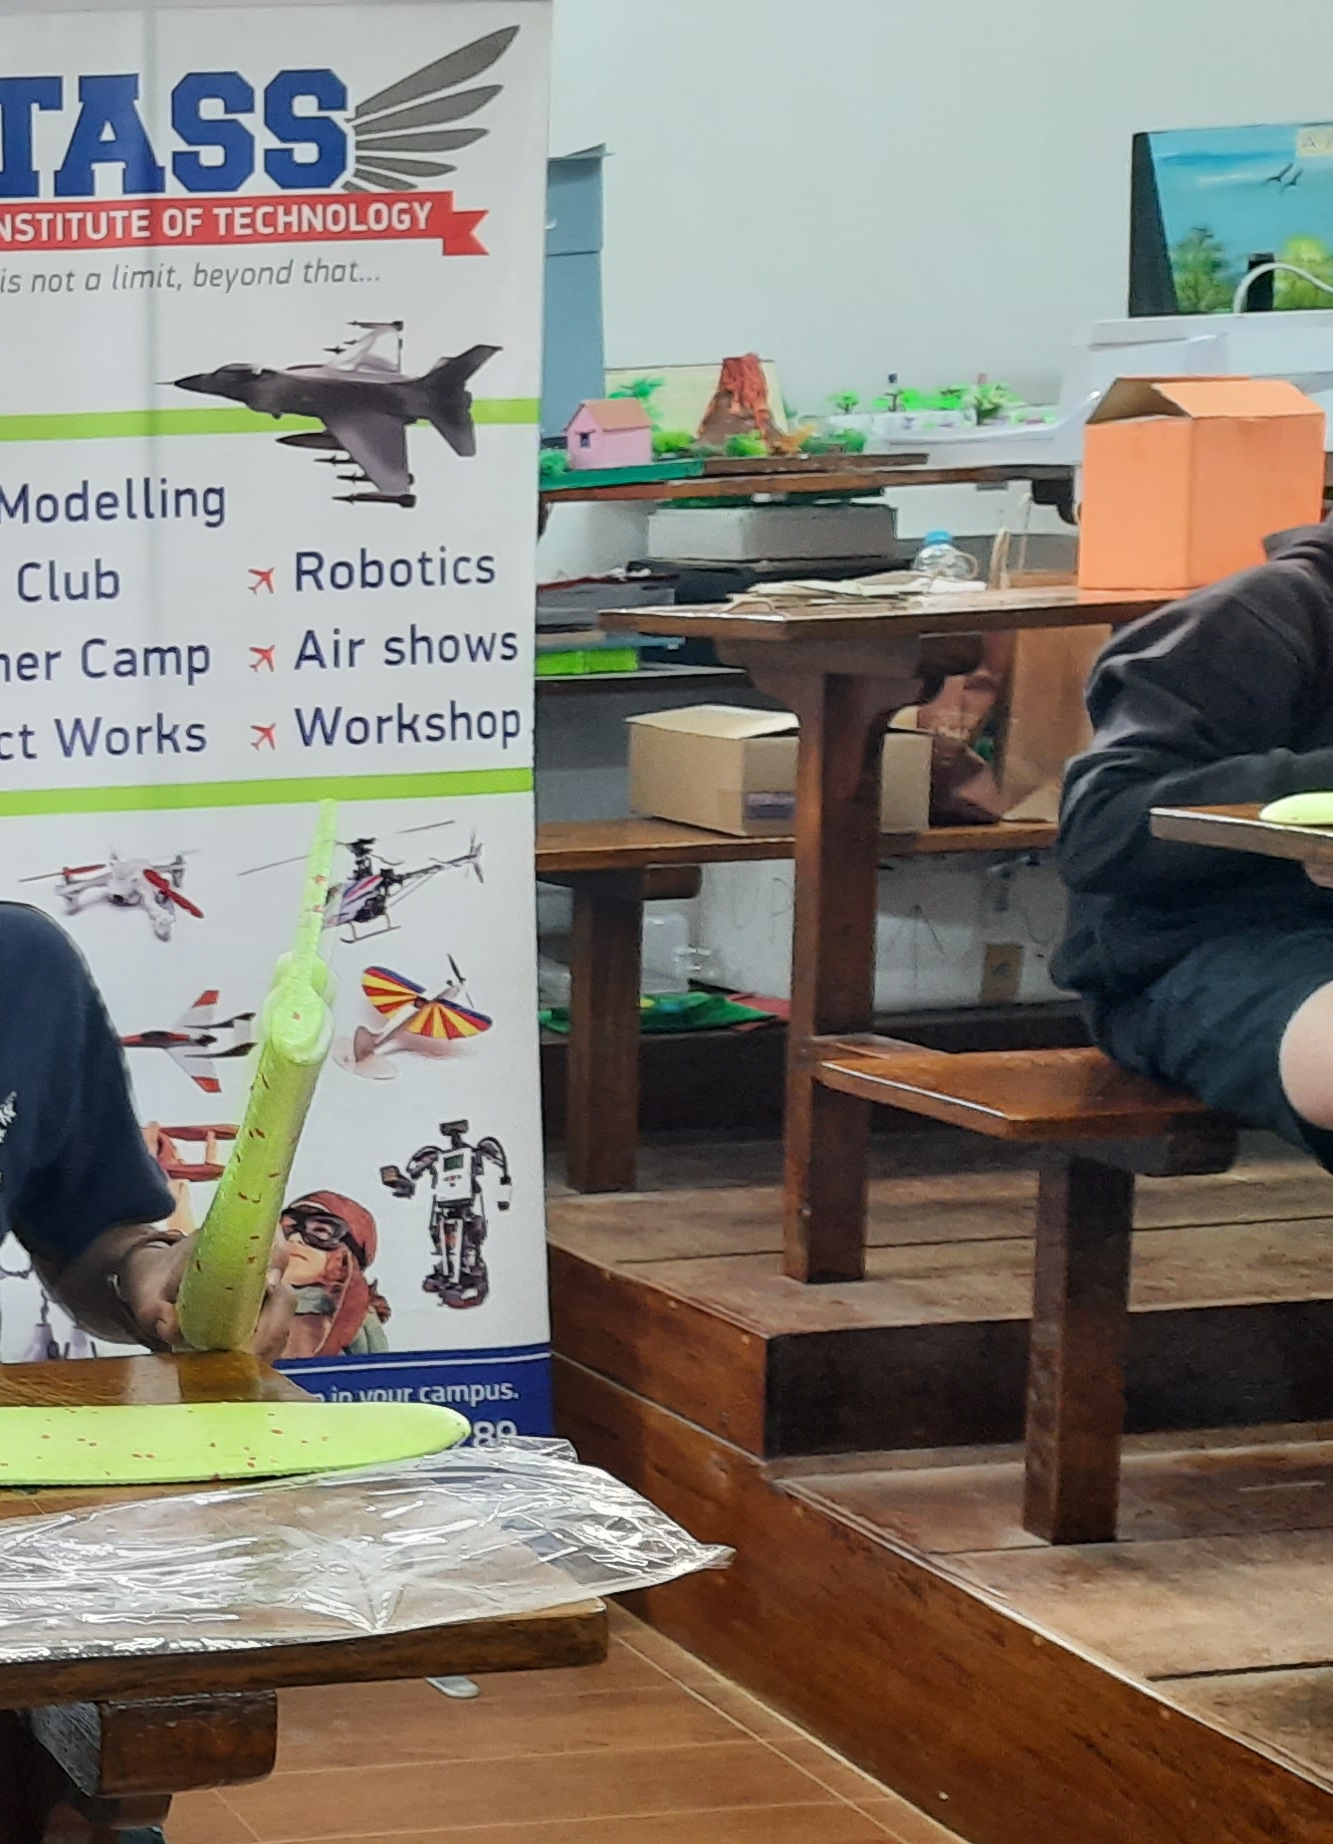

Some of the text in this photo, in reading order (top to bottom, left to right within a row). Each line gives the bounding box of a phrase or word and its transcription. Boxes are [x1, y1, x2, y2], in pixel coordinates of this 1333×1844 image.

[162, 207, 204, 237] OF
[212, 201, 433, 236] TECHNOLOGY
[0, 267, 23, 294] is
[30, 270, 76, 294] not
[84, 272, 102, 292] a
[111, 262, 183, 293] limit,
[192, 258, 295, 295] beyond
[302, 257, 380, 285] that...
[17, 558, 121, 603] Club
[294, 545, 496, 593] Robotics
[80, 637, 211, 686] Camp
[293, 623, 519, 670] Air shows
[53, 711, 208, 758] Works
[293, 699, 522, 750] Workshop
[418, 1381, 521, 1407] campus.
